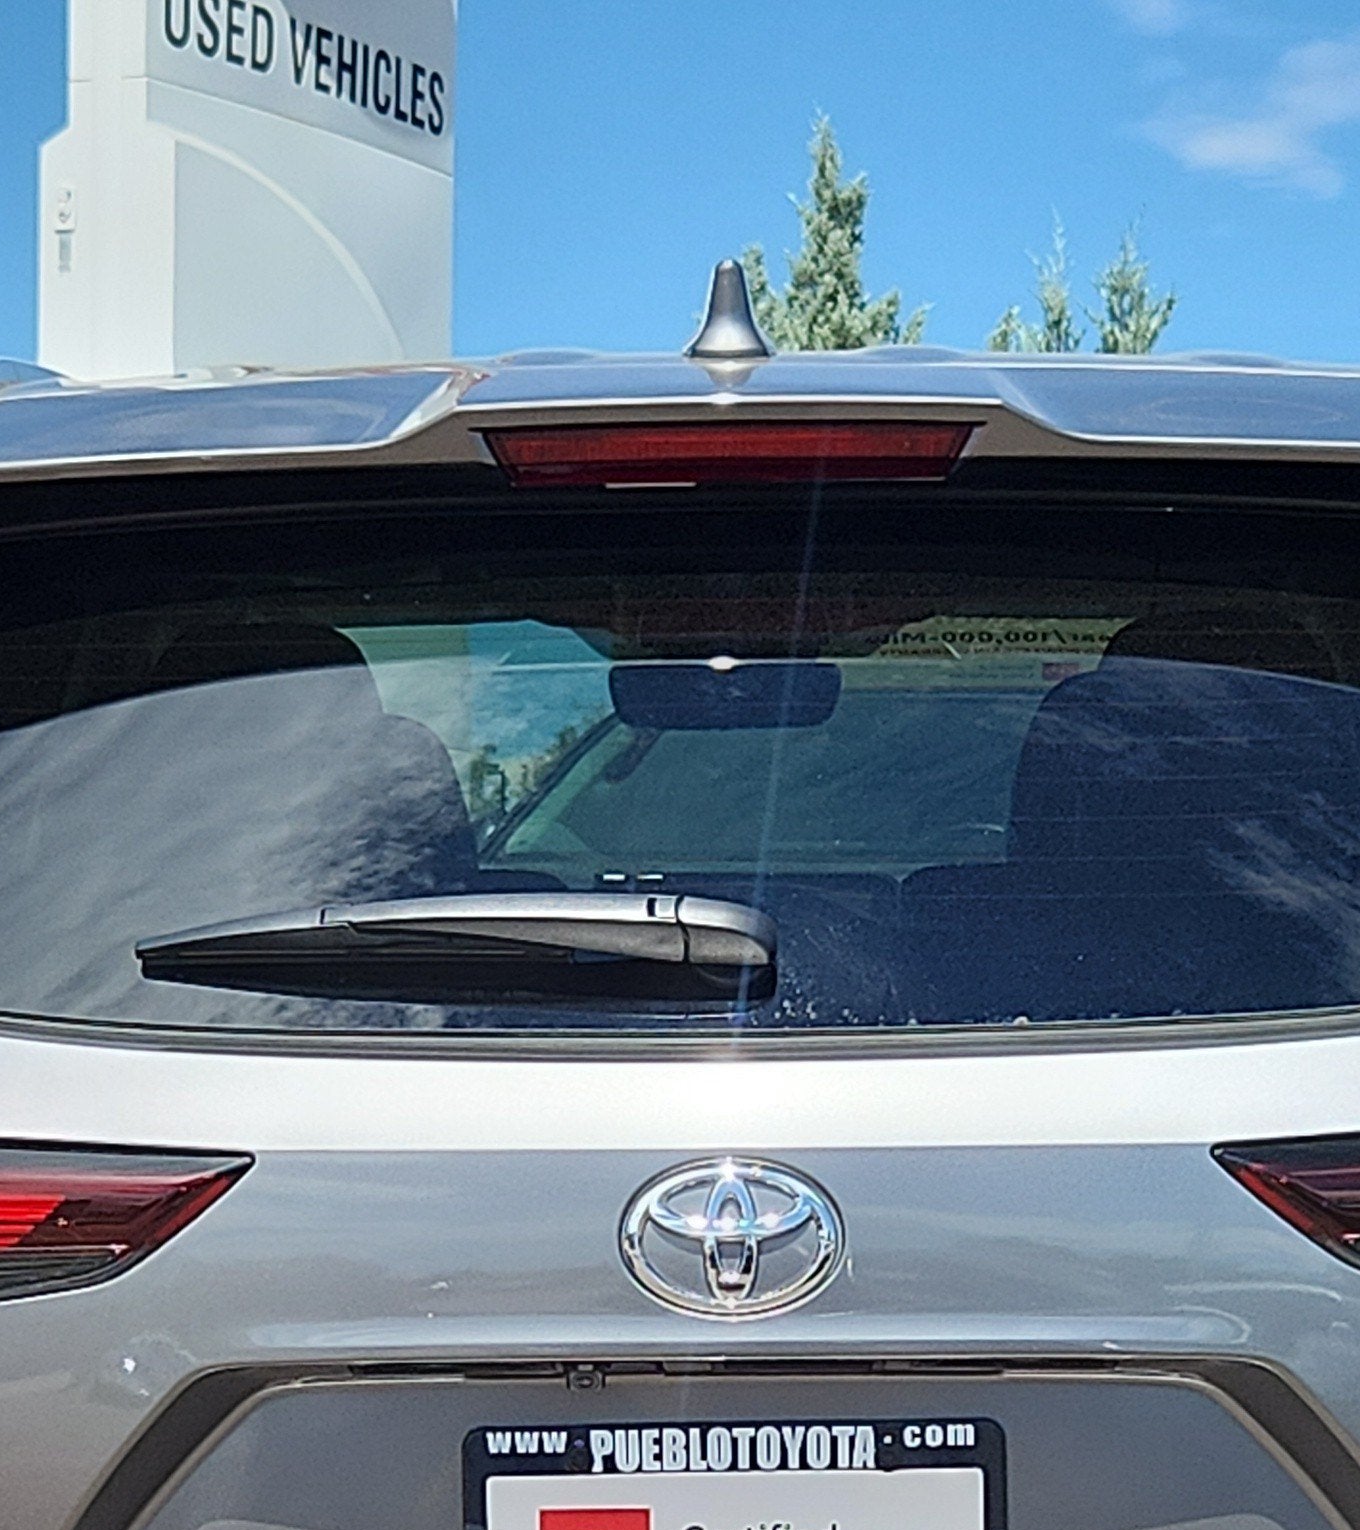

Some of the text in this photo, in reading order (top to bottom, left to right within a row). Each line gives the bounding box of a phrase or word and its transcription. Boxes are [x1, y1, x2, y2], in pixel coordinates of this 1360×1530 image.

[163, 0, 445, 137] USED VEHICLES
[590, 1425, 877, 1473] PUEBLOTOYOTA
